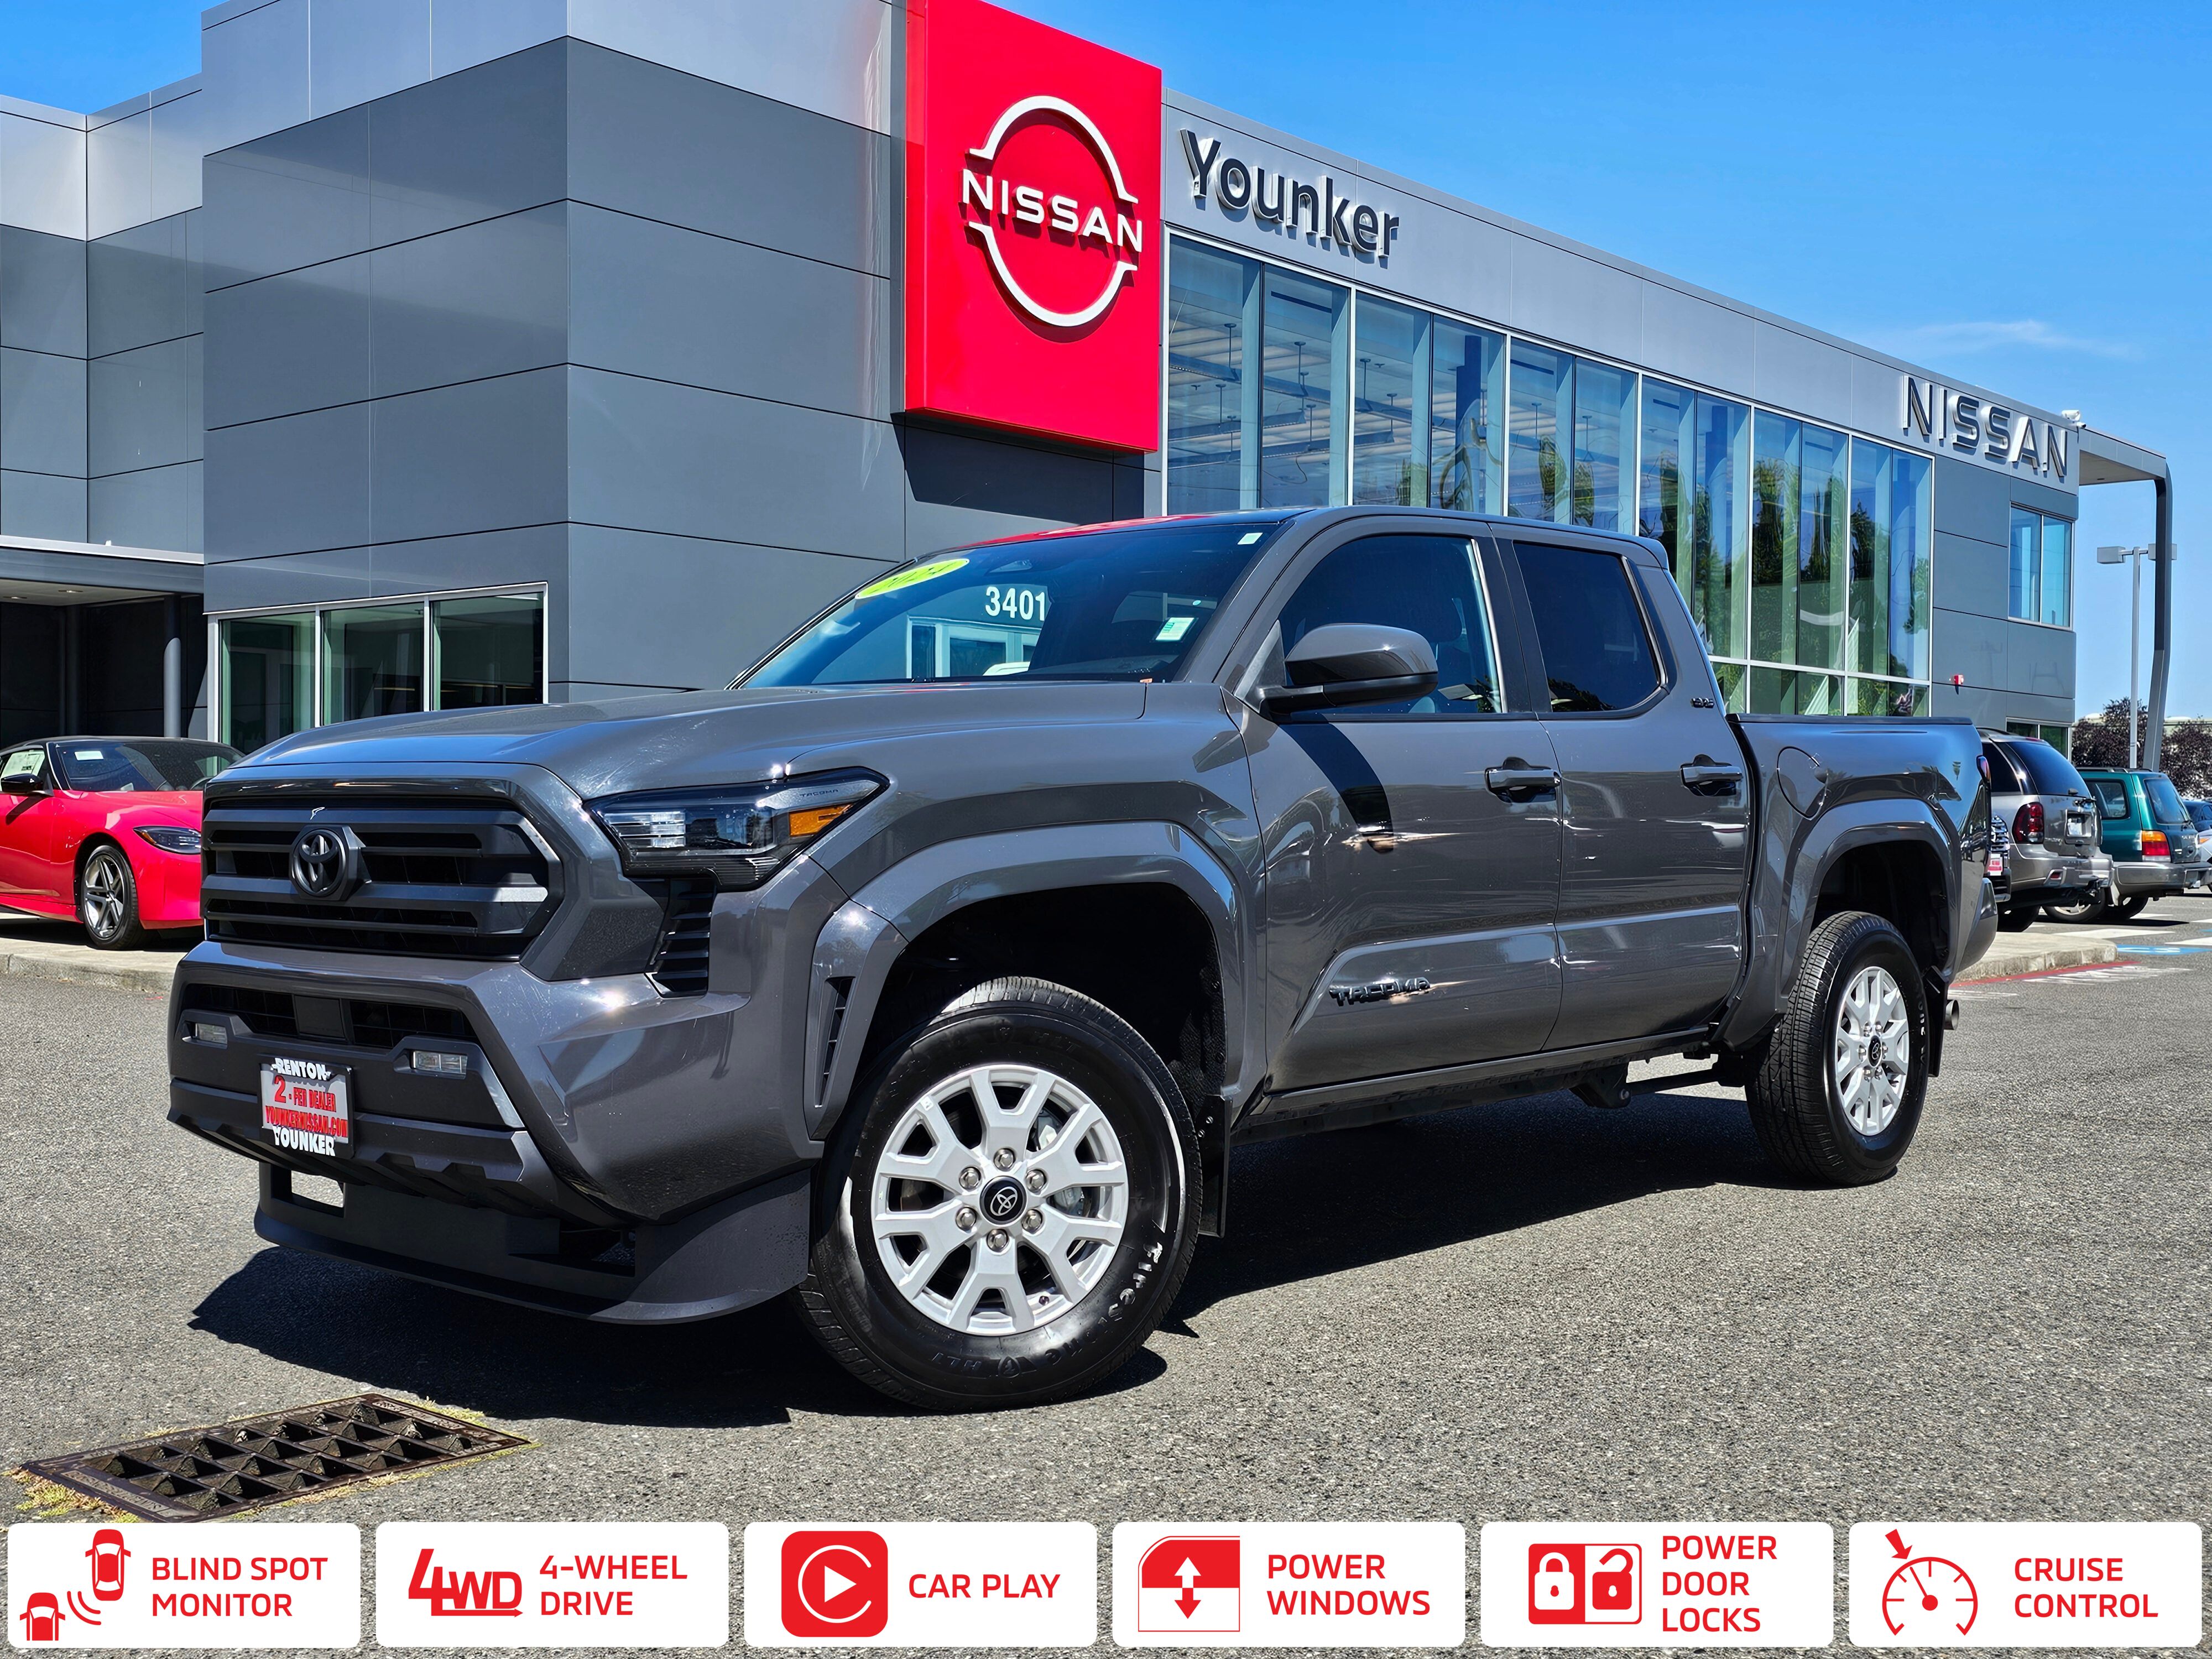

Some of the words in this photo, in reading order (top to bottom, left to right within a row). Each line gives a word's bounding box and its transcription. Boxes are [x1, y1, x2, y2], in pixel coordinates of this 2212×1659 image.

[960, 168, 1144, 253] NISSAN
[1180, 127, 1401, 258] Younker
[1902, 375, 2068, 477] NISSAN
[985, 586, 1045, 622] 3401
[800, 789, 839, 797] TACOMA
[272, 1057, 330, 1081] RENTON
[274, 1075, 286, 1103] 2
[309, 1089, 337, 1113] DEALER
[272, 1125, 336, 1157] YOUNKER
